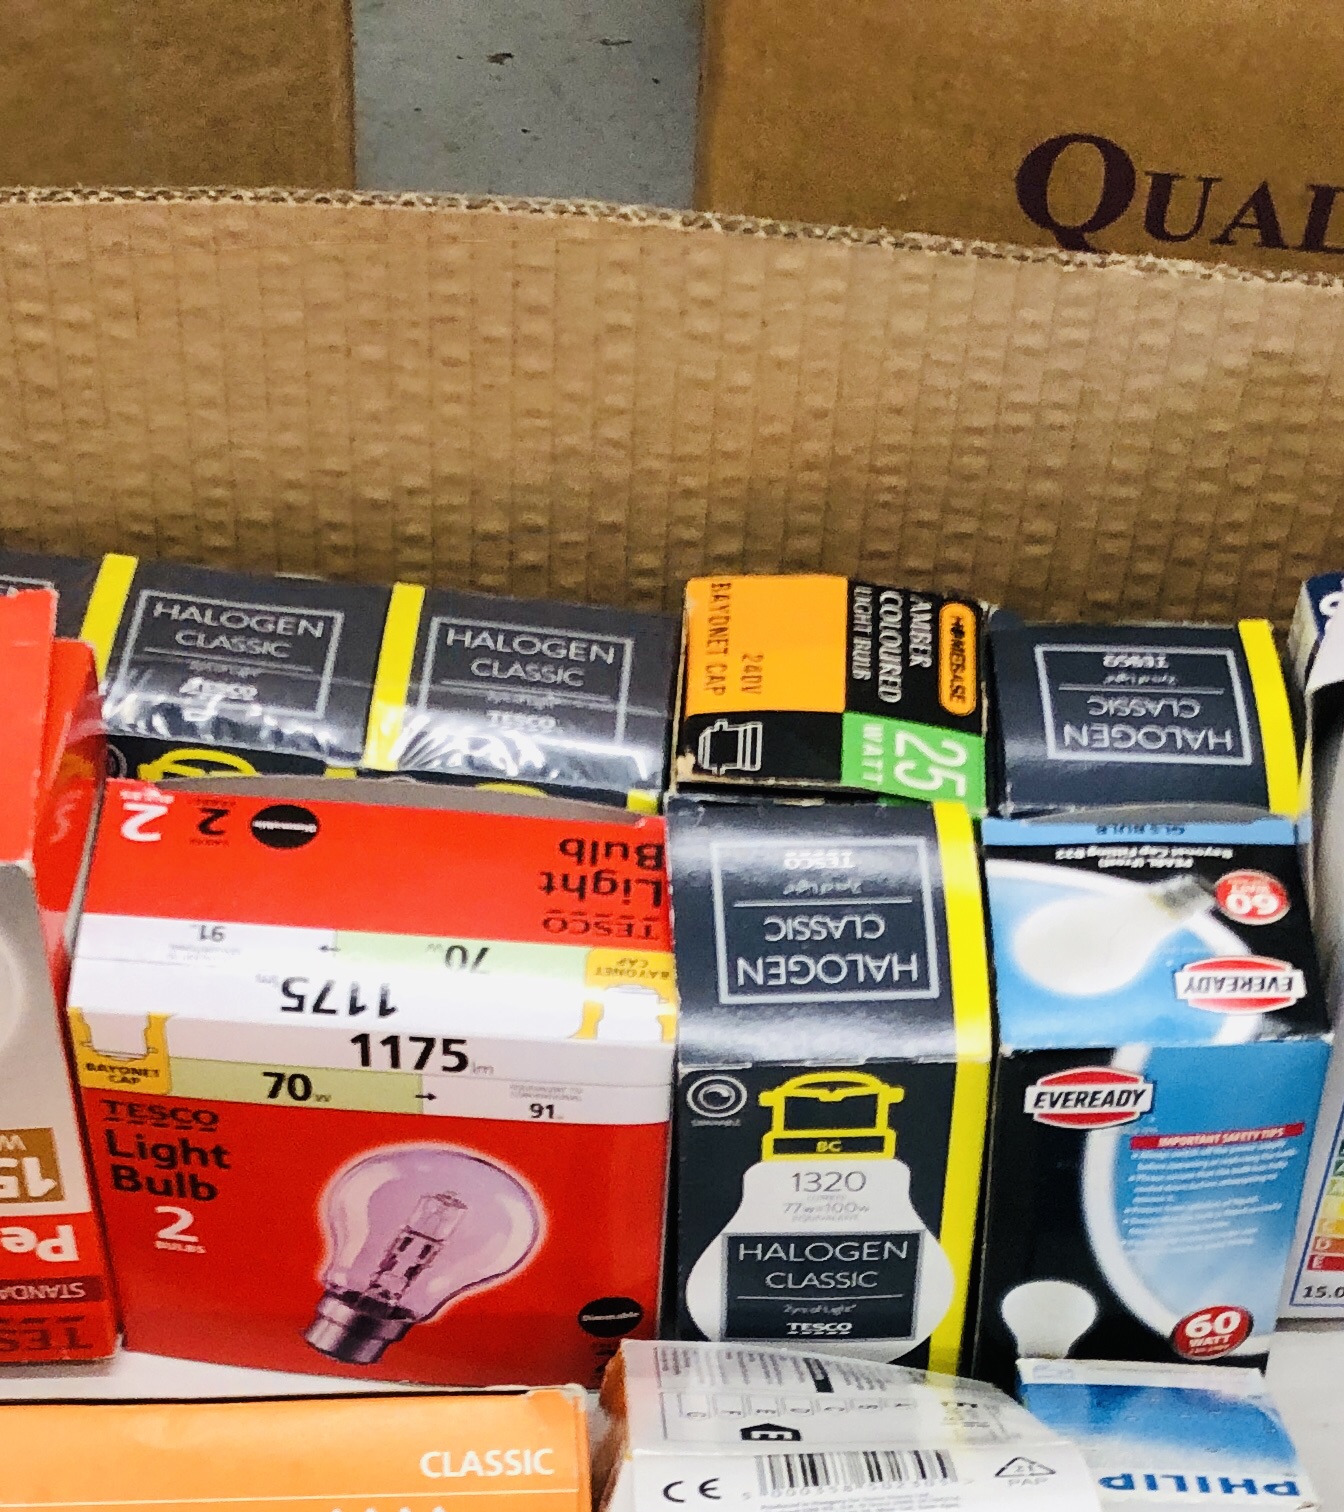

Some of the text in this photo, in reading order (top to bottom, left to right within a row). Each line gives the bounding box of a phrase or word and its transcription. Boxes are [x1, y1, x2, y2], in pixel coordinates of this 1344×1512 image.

[153, 601, 326, 640] HALOGEN
[909, 595, 933, 668] AMBER
[174, 630, 290, 659] CLASSIC
[445, 628, 616, 665] HALOGEN
[705, 582, 732, 696] BAYONET CAP
[878, 590, 904, 703] COLOURED
[470, 657, 585, 688] CLASSIC
[948, 615, 967, 704] HOMEBASE
[1087, 696, 1200, 718] CLASSIC
[1064, 723, 1233, 750] HALOGEN
[862, 724, 884, 785] WATT
[894, 729, 967, 797] 25
[121, 802, 169, 843] 2
[558, 837, 664, 872] Bulb
[784, 850, 856, 869] TESCO
[538, 871, 663, 908] Light
[1226, 893, 1279, 915] 60
[543, 909, 660, 940] TESCO
[764, 915, 886, 941] CLASSIC
[737, 953, 918, 986] HALOGEN
[1184, 976, 1294, 993] EVEREADY
[102, 1099, 220, 1131] TESCO
[1033, 1089, 1147, 1111] EVEREADY
[103, 1130, 231, 1171] Light
[110, 1165, 219, 1202] Bulb
[792, 1171, 867, 1193] 1320
[154, 1205, 200, 1244] 2
[737, 1240, 908, 1262] HALOGEN
[765, 1271, 879, 1289] CLASSIC
[786, 1321, 853, 1335] TESCO
[1184, 1310, 1241, 1336] 60
[420, 1447, 556, 1479] CLASSIC
